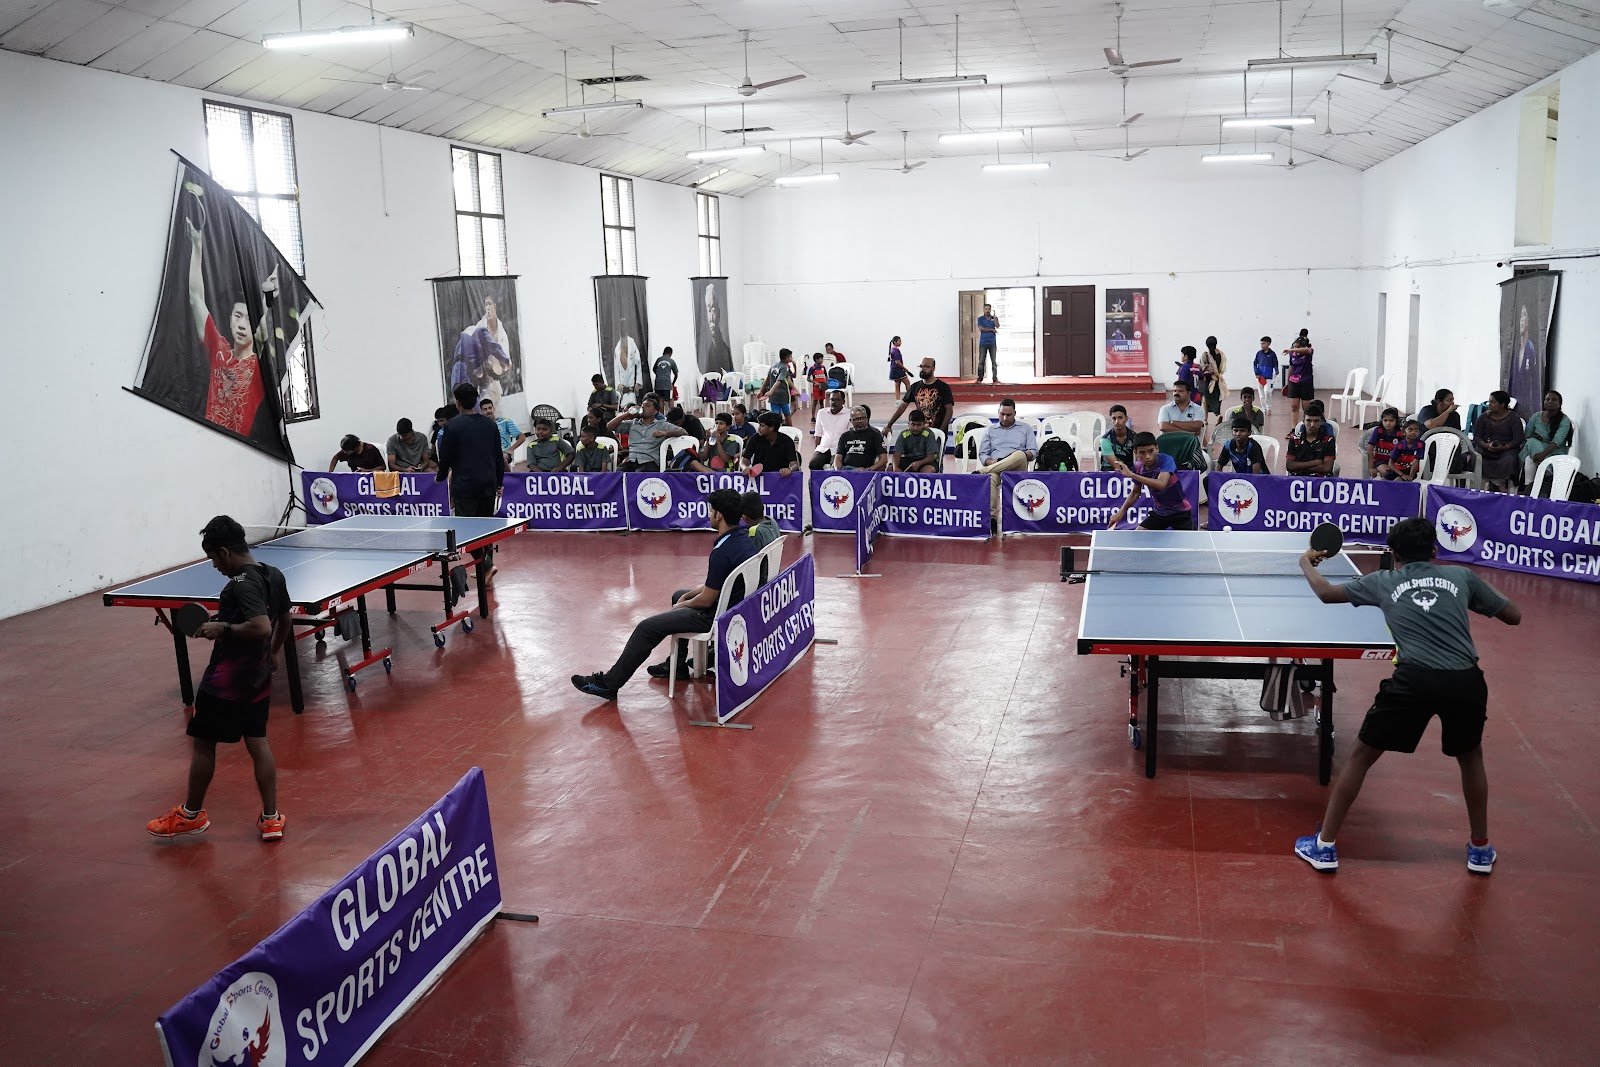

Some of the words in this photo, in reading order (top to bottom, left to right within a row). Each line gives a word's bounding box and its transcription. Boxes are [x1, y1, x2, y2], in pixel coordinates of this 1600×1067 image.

[358, 476, 420, 496] GLAL
[525, 475, 594, 496] GLOBAL
[696, 474, 770, 496] GLOBAL
[881, 475, 957, 500] GLOBAL
[1080, 477, 1154, 499] GLOBA
[1290, 479, 1380, 506] GLOBAL
[506, 502, 562, 519] SPORTS
[565, 501, 618, 519] CENTRE
[678, 501, 712, 519] SPO
[880, 504, 918, 525] ORTS
[923, 507, 982, 528] CENTRE
[1339, 513, 1409, 534] CENTR
[1509, 509, 1600, 546] GLOBAL
[1480, 539, 1555, 570] SPORTS
[761, 570, 799, 623] GLOBAL
[1391, 581, 1412, 603] GLOBAL
[1411, 577, 1434, 589] SPORTS
[1434, 577, 1459, 598] CENTRE
[751, 625, 786, 674] SPORTS
[330, 810, 452, 951] GLOBAL
[296, 928, 403, 1061] SPORTS
[408, 842, 492, 953] CENTRE
[210, 1007, 229, 1050] Global
[226, 984, 253, 1009] Sports
[254, 979, 274, 1000] Centre
